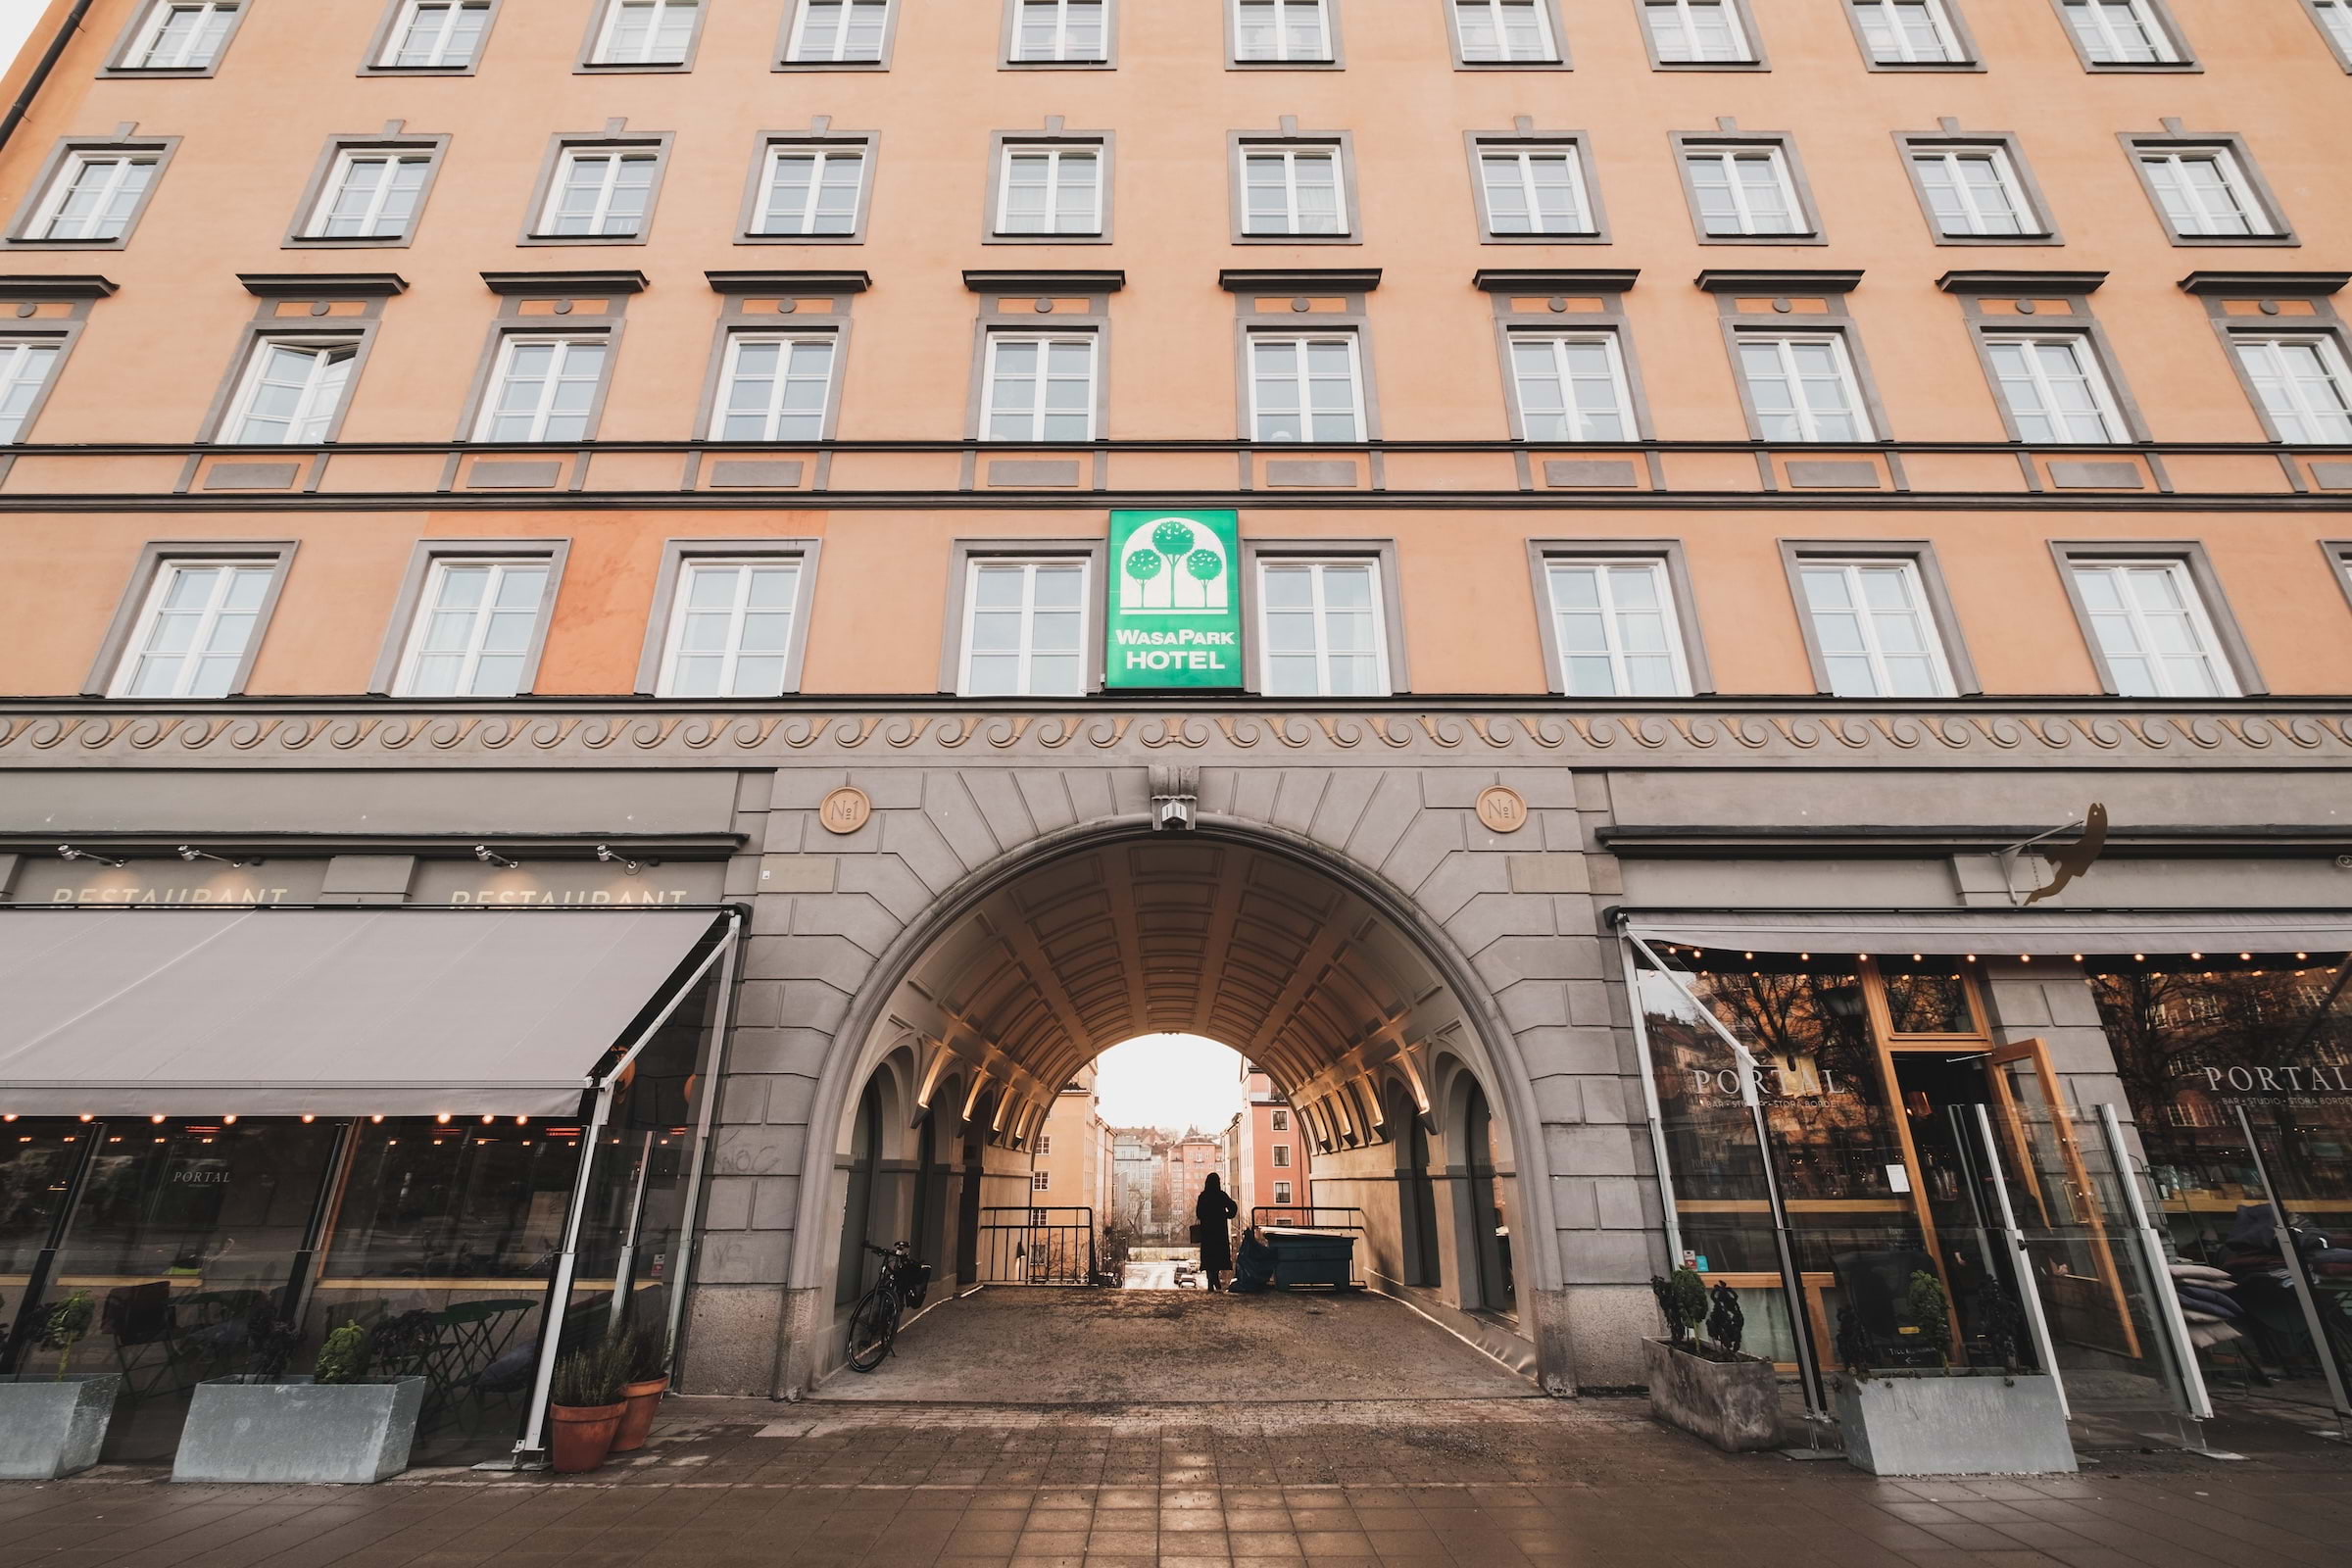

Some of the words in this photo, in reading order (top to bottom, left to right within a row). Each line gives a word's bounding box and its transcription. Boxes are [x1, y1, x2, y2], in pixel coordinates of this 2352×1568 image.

[1116, 628, 1235, 646] WASAPARK
[1126, 651, 1226, 669] HOTEL
[1692, 1069, 1845, 1095] PORTAL
[2202, 1066, 2352, 1092] PORTAL
[1706, 1100, 1725, 1108] BAR
[2222, 1097, 2241, 1105] BAR
[2247, 1097, 2281, 1105] STUDIO
[2287, 1097, 2319, 1105] STORA
[172, 1171, 231, 1183] PORTAL
